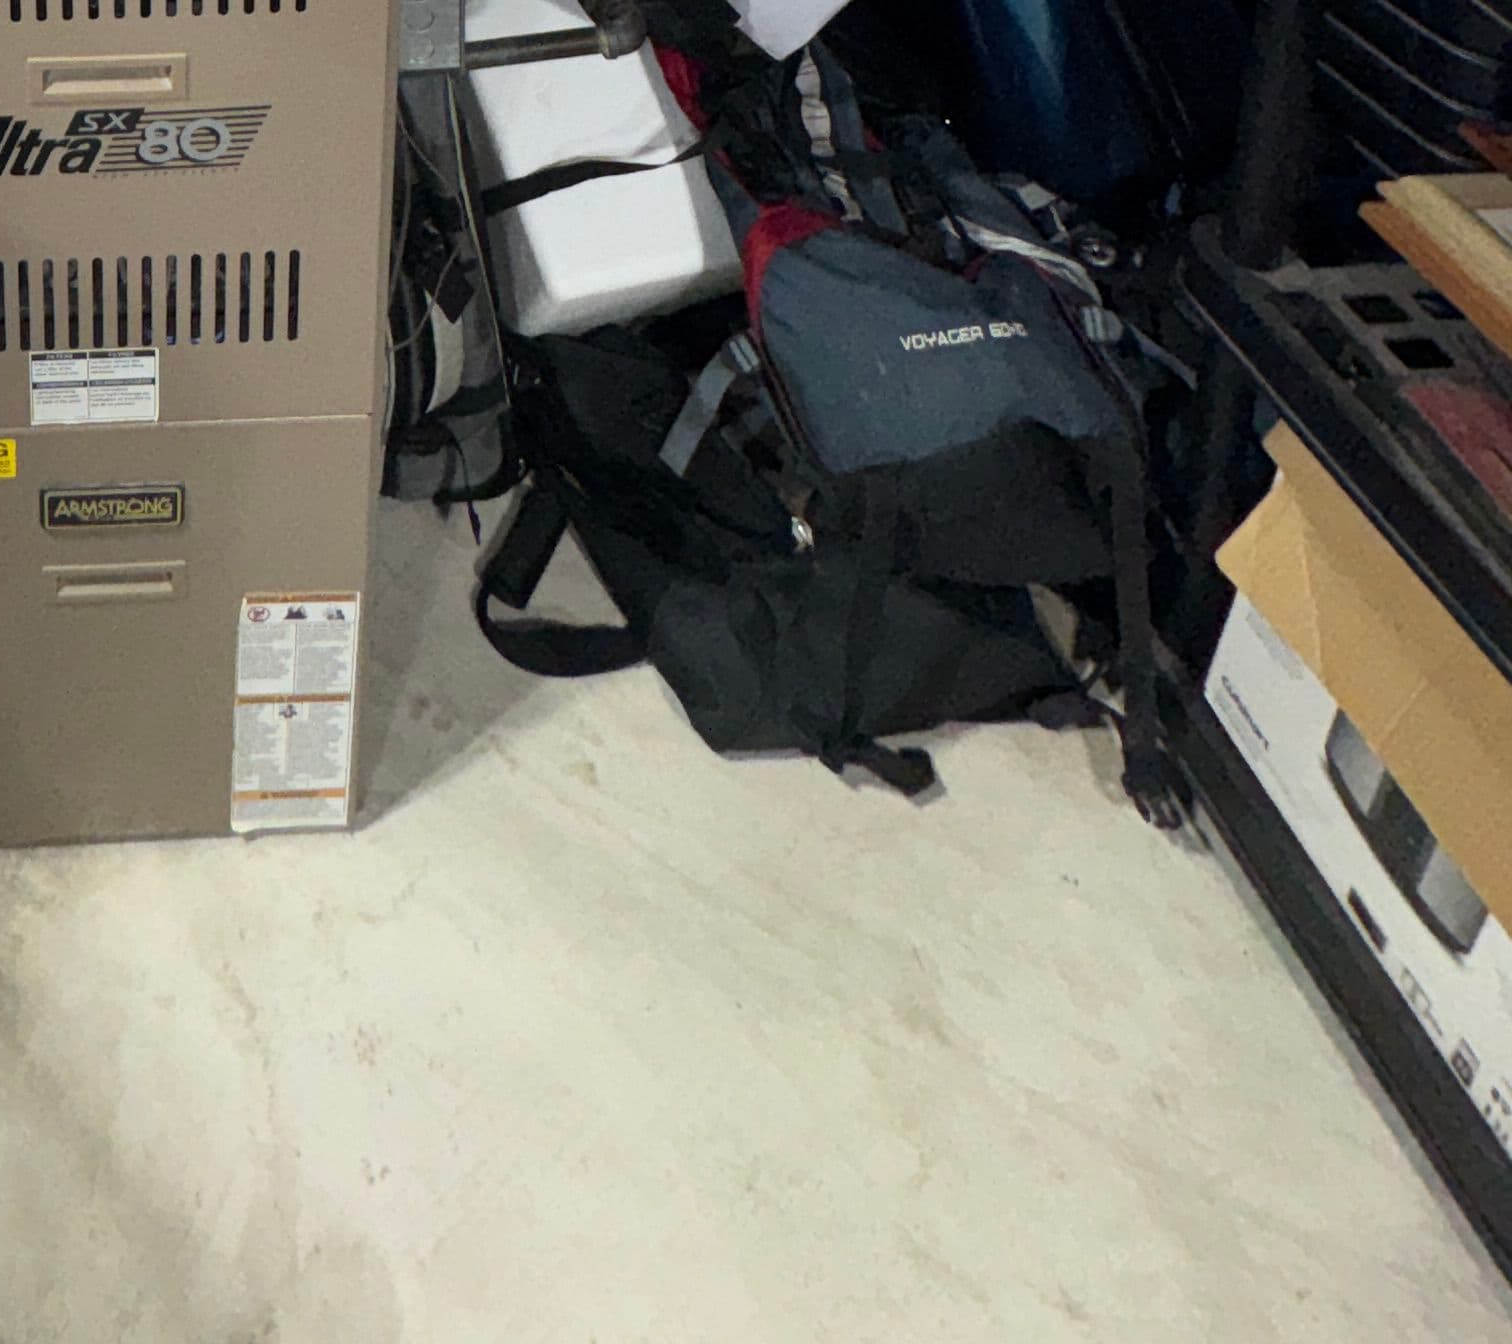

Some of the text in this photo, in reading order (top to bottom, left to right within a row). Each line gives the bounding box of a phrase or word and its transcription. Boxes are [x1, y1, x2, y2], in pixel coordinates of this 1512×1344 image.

[78, 111, 130, 133] SX
[136, 117, 233, 165] 80
[899, 325, 985, 351] VOYAGER
[54, 496, 173, 518] ARMSTRONG
